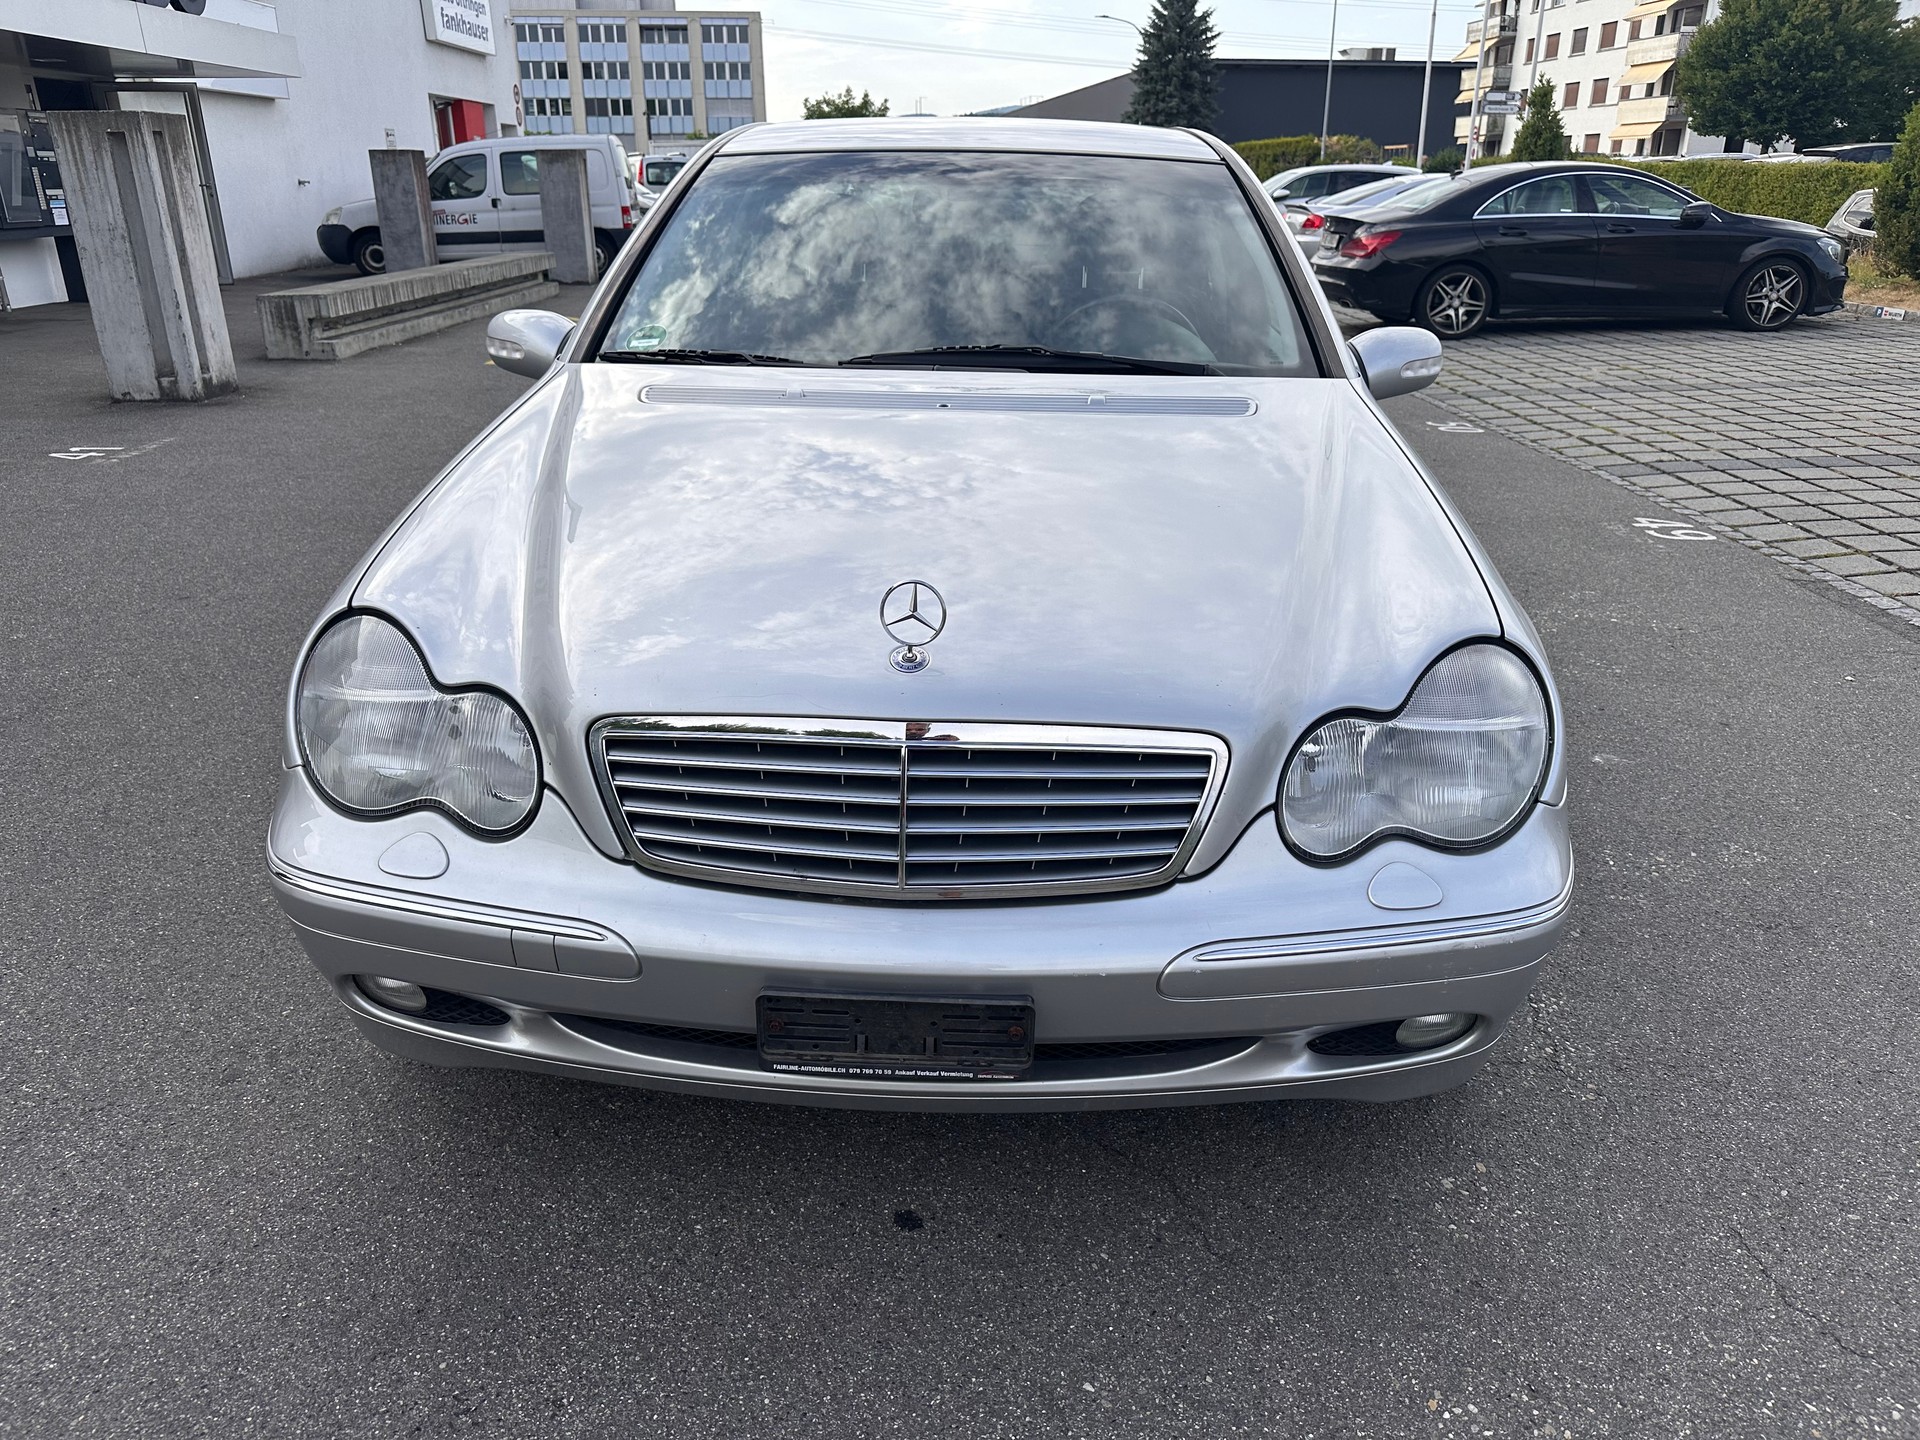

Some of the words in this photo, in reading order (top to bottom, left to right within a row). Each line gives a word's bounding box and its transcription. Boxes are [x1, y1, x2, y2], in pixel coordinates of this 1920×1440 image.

[440, 6, 489, 41] fankhauser
[1631, 517, 1718, 540] 49
[773, 1064, 846, 1073] FAIRLINE-AUTOMOBILE.CH
[940, 1071, 974, 1079] Vermietung
